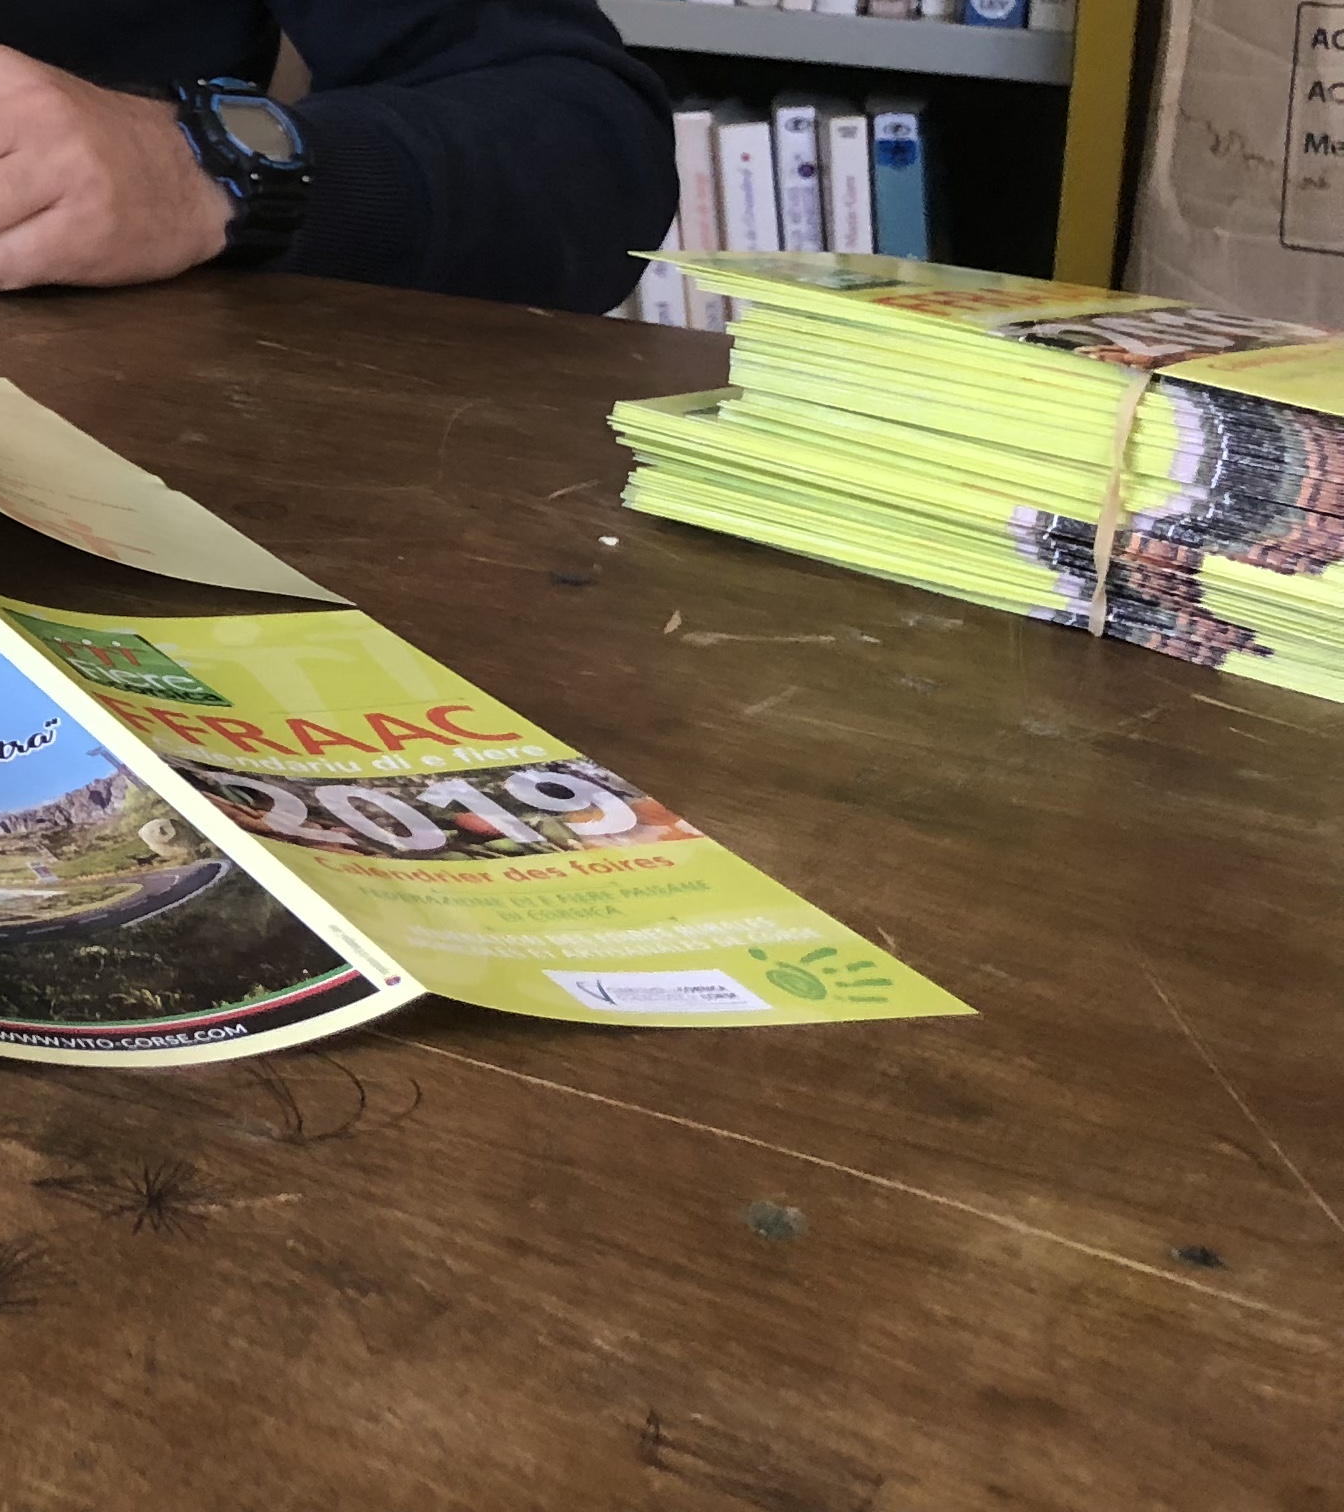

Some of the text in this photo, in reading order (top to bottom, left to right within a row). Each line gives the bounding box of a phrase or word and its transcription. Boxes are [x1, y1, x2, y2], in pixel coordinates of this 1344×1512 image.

[81, 656, 207, 694] Fiere
[94, 704, 522, 757] FFRAAC
[373, 751, 411, 773] di
[452, 739, 548, 765] fiere
[210, 767, 639, 853] 2019
[313, 850, 674, 886] Calendrier des foires
